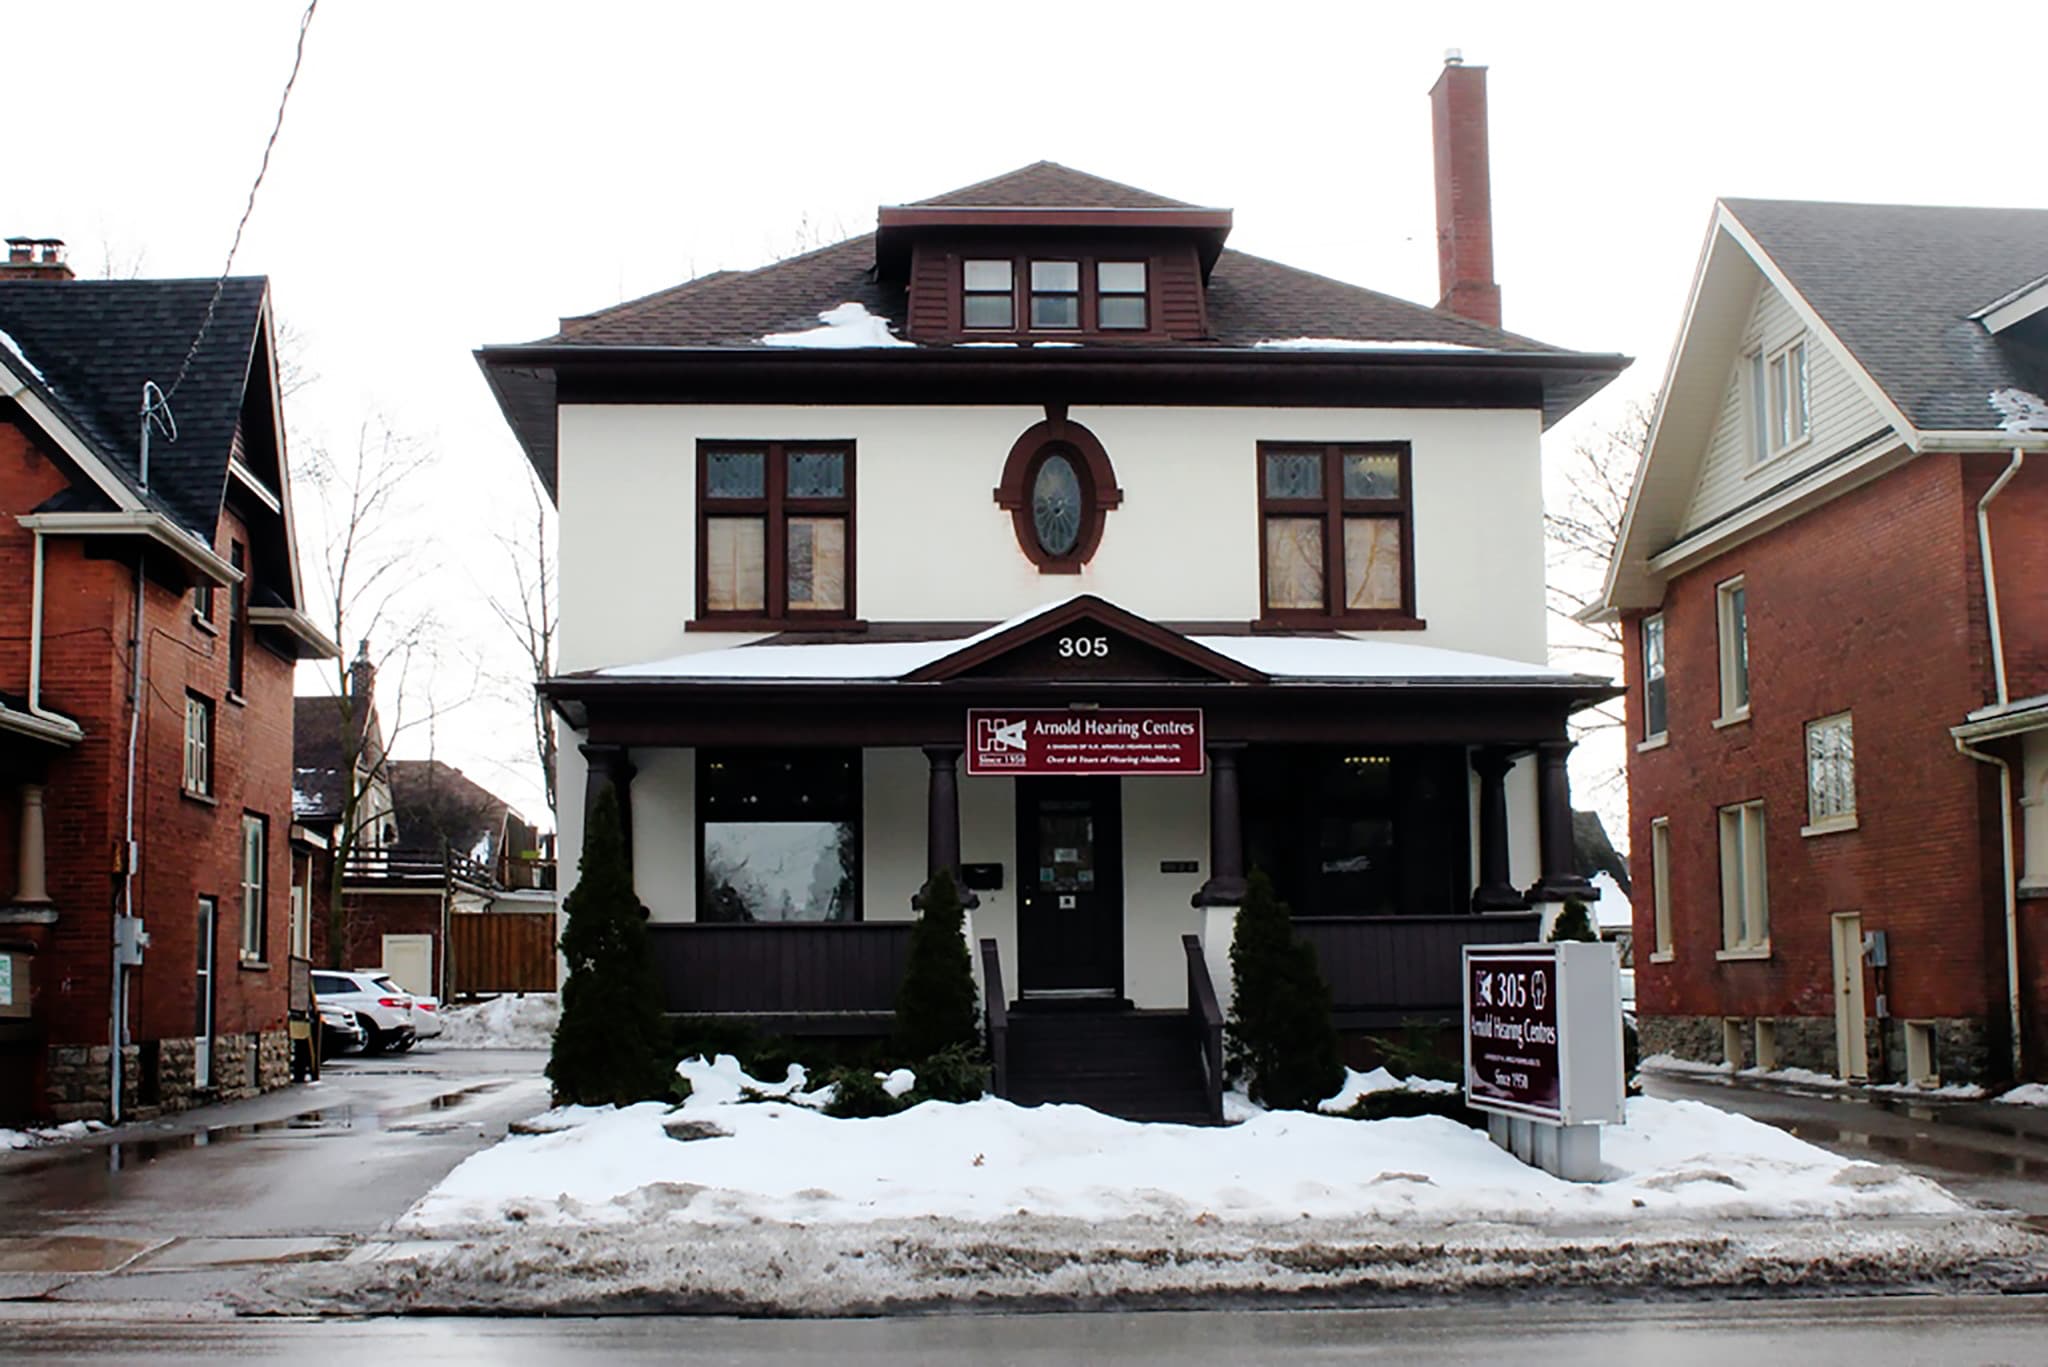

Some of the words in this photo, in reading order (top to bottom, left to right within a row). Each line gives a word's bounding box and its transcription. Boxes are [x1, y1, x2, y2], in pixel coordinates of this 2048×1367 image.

[1059, 637, 1109, 657] 305
[1033, 718, 1081, 735] Arnold
[1085, 718, 1140, 739] Hearing
[1143, 719, 1195, 735] Centres
[1100, 754, 1110, 764] of
[1497, 973, 1526, 1007] 305
[1472, 1012, 1493, 1038] Arnold
[1494, 1016, 1525, 1049] Hearing
[1524, 1018, 1556, 1045] Centres
[1494, 1068, 1511, 1087] Since
